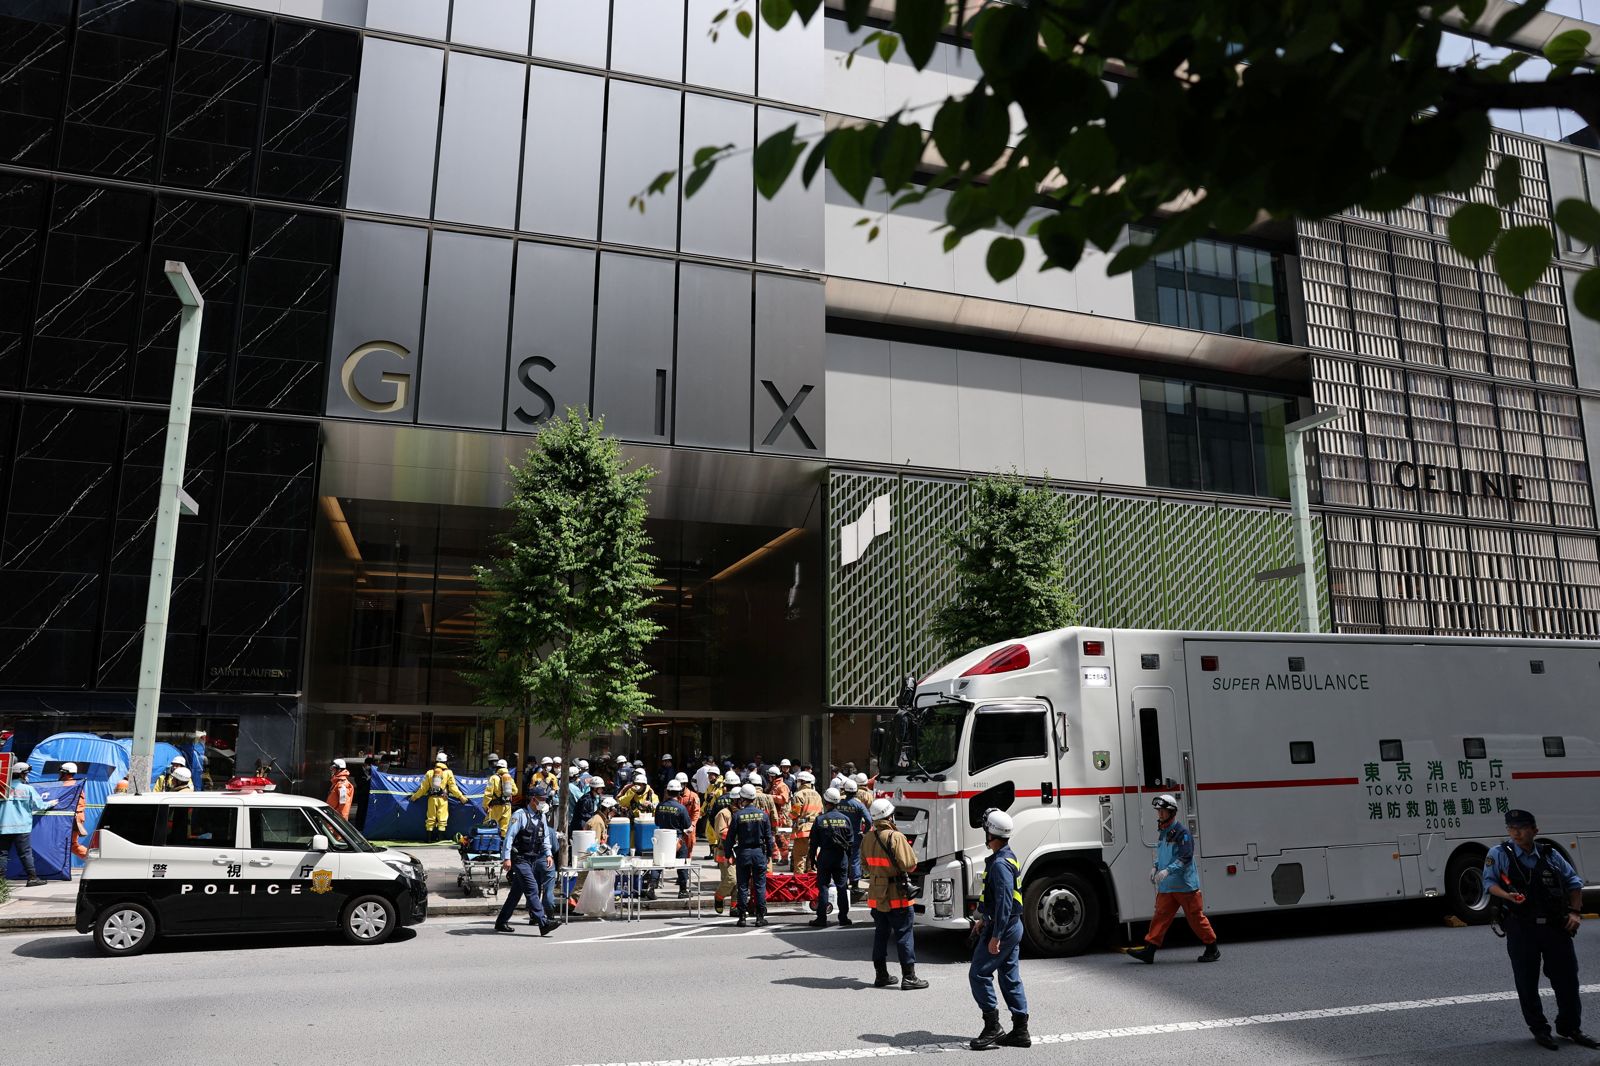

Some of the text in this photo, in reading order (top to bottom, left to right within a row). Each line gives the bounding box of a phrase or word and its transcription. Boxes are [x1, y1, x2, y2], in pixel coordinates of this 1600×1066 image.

[1394, 460, 1527, 503] CELINE
[209, 666, 291, 679] SAINT LAURENT
[1212, 673, 1370, 691] SUPER AMBULANCE
[1363, 759, 1503, 782] 東京消防庁
[1366, 780, 1509, 797] TOKYO FIRE DEPT.
[1368, 796, 1510, 820] 消防救助機動部隊
[1426, 817, 1461, 830] 20066
[151, 863, 314, 878] 警視庁
[180, 884, 302, 895] POLICE
